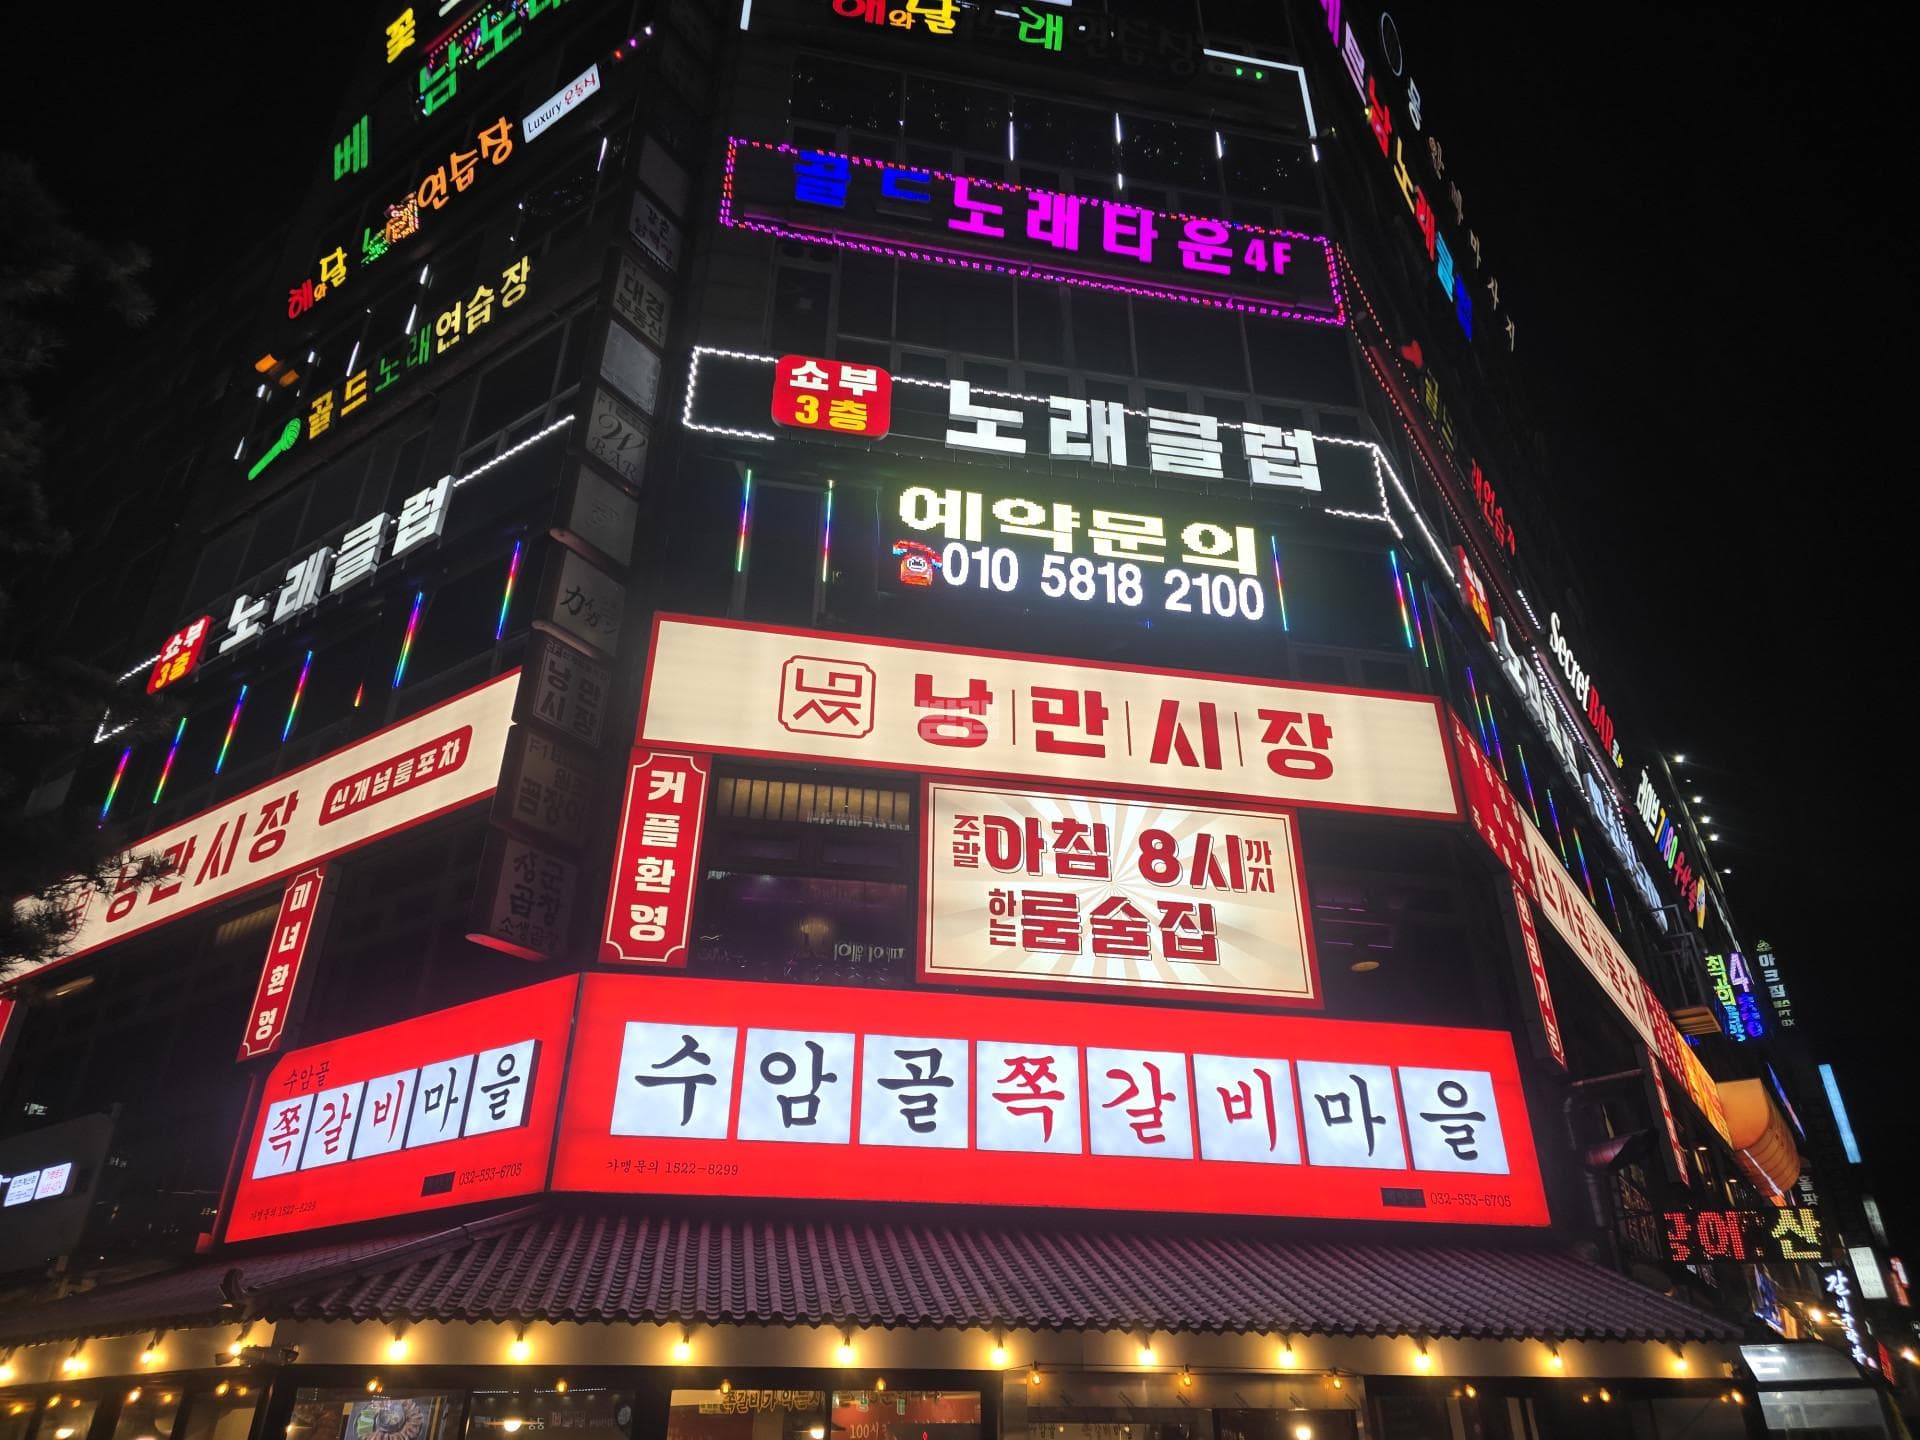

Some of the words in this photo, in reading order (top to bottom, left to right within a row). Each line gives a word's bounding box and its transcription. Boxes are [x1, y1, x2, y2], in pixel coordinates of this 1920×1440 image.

[526, 101, 562, 134] Luxury
[1243, 238, 1292, 275] 4F
[788, 359, 881, 398] 쇼부
[794, 391, 870, 433] 3층
[944, 379, 1324, 494] 노래클럽
[218, 474, 457, 655] 노래클럽
[898, 485, 1260, 579] 예약문의
[940, 541, 1021, 593] 010
[1039, 553, 1145, 607] 5818
[1162, 568, 1266, 621] 2100
[153, 652, 190, 690] 3층
[161, 617, 207, 664] 쇼부
[1550, 611, 1591, 712] Secret
[1587, 685, 1614, 754] BAR
[912, 669, 1336, 783] 낭만시장
[328, 736, 463, 815] 신개념룸포차
[628, 767, 688, 947] 커플환영
[950, 812, 982, 873] 주말
[983, 814, 1113, 883] 아침
[1137, 828, 1249, 895] 8시
[1244, 837, 1277, 894] 까지
[254, 880, 310, 1043] 미녀환영
[988, 886, 1018, 949] 하는
[1019, 889, 1220, 964] 룸술집
[267, 1052, 521, 1168] 쪽갈비마을
[282, 1060, 331, 1095] 수암골
[633, 1032, 1489, 1165] 수암골쪽갈비마을
[458, 1162, 523, 1187] 032-553-6705
[664, 1161, 740, 1177] 1522-8299
